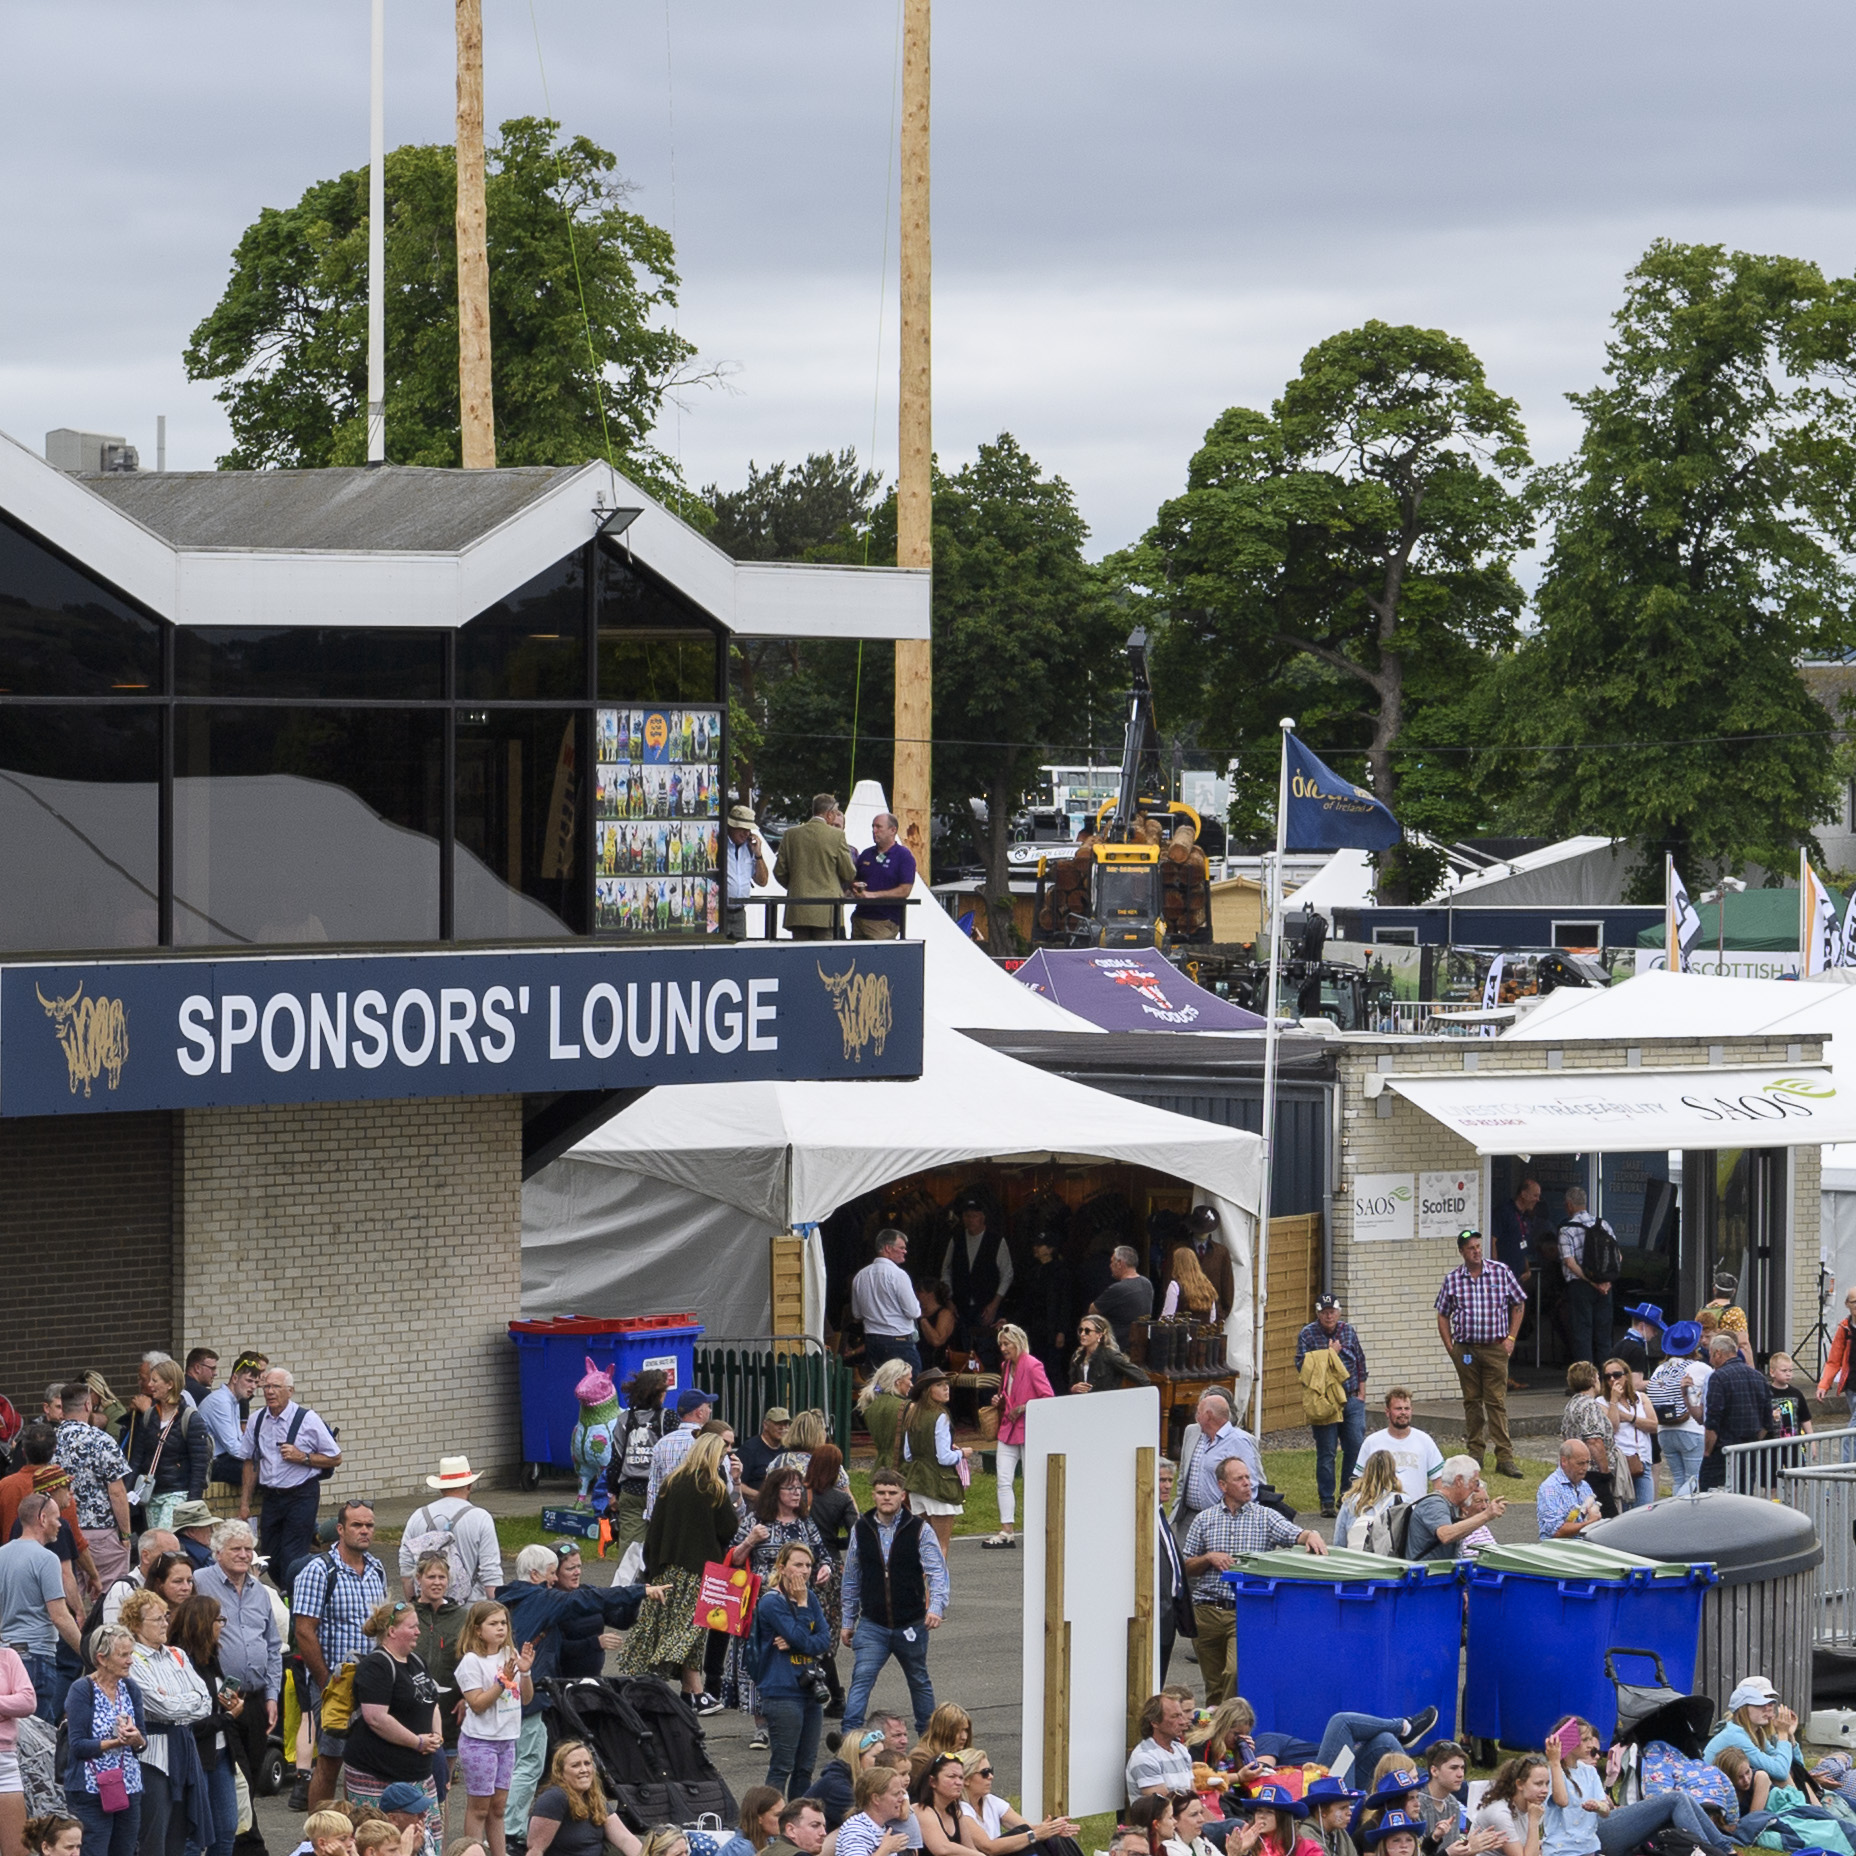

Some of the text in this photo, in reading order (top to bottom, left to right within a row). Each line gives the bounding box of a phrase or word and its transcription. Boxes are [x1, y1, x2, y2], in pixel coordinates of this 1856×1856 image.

[1693, 962, 1784, 978] SCOTTISH
[1142, 1003, 1199, 1024] PRODUCTS
[177, 978, 779, 1076] SPONSORS' LOUNGE
[1681, 1093, 1813, 1121] SAOS
[1355, 1197, 1396, 1217] SAOS
[1422, 1197, 1465, 1215] ScotEID
